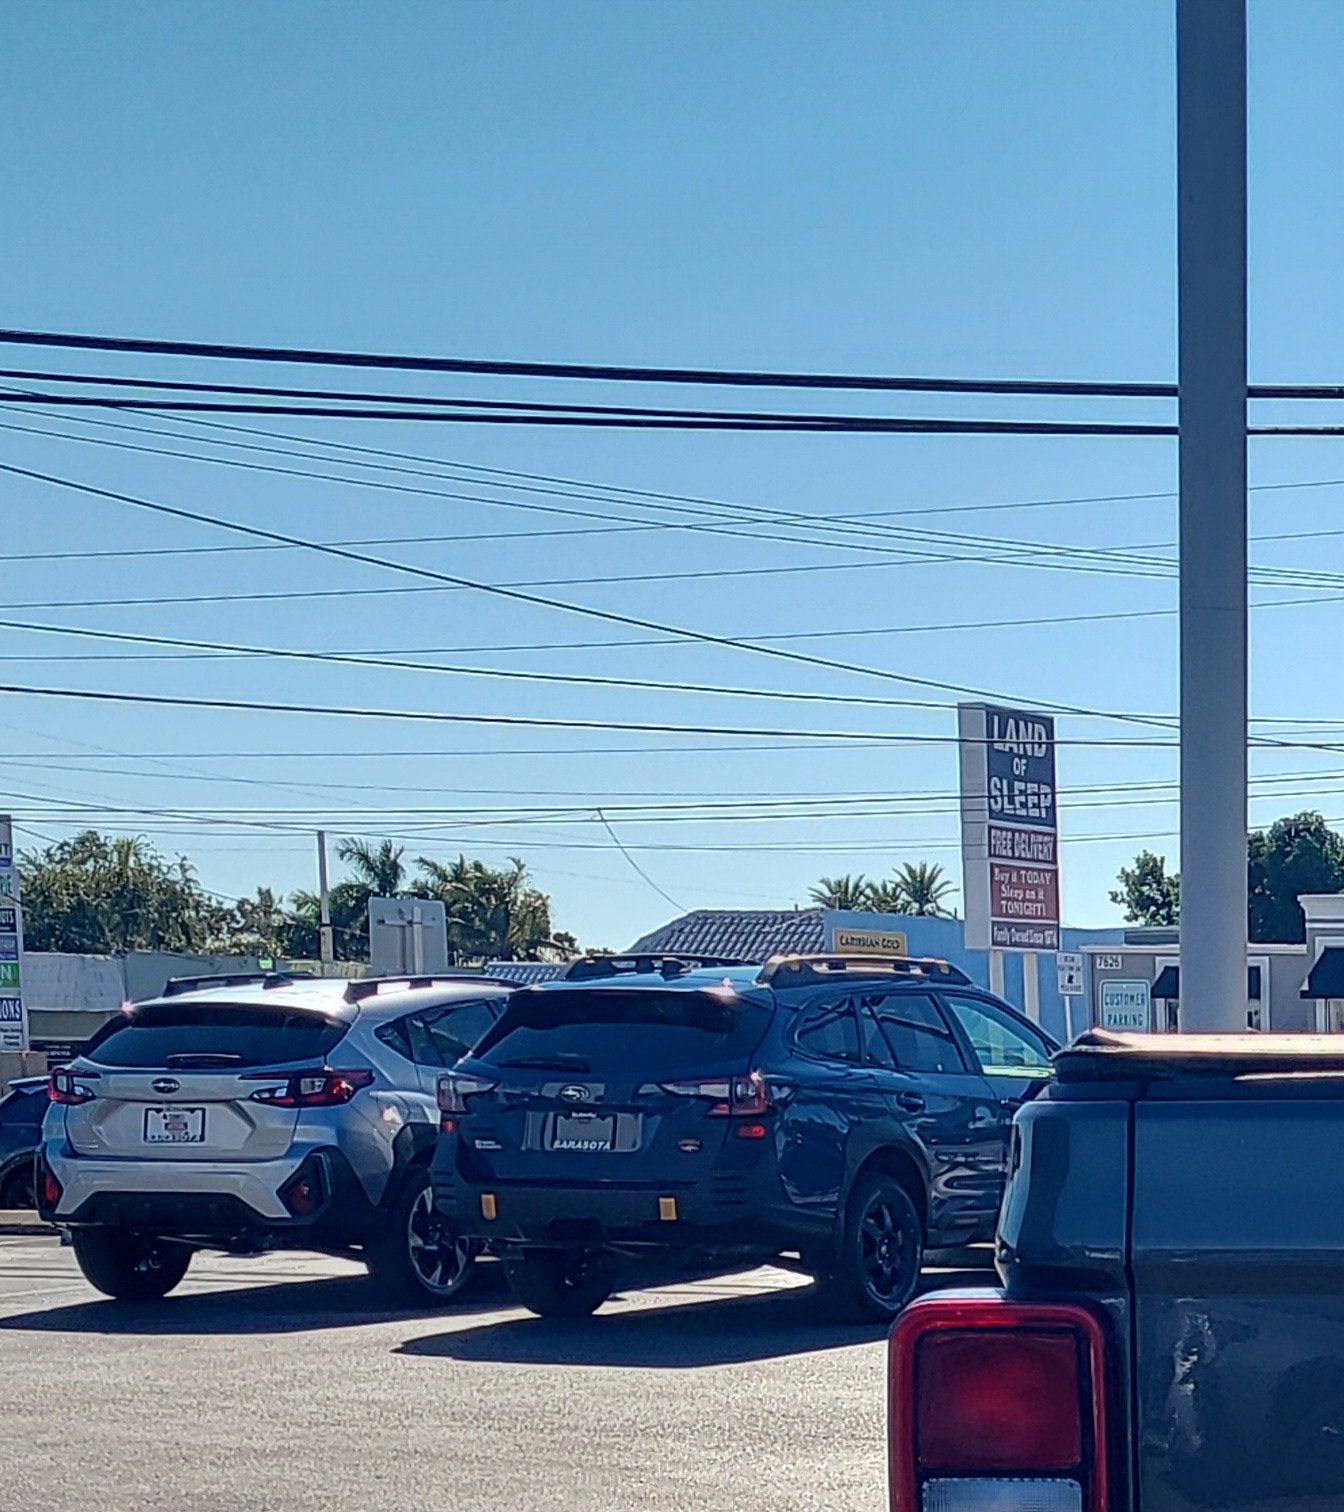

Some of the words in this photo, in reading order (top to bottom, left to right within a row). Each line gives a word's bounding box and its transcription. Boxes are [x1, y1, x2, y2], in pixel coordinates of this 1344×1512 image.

[992, 714, 1048, 758] LAND
[1012, 756, 1028, 776] OF
[989, 776, 1052, 819] SLEEP
[991, 828, 1013, 857] FREE
[1014, 831, 1054, 861] DELIVERY
[1020, 870, 1052, 885] TODAY
[1098, 955, 1120, 968] 7626
[1104, 992, 1146, 1006] CUSTOMER
[1107, 1013, 1143, 1027] PARKING
